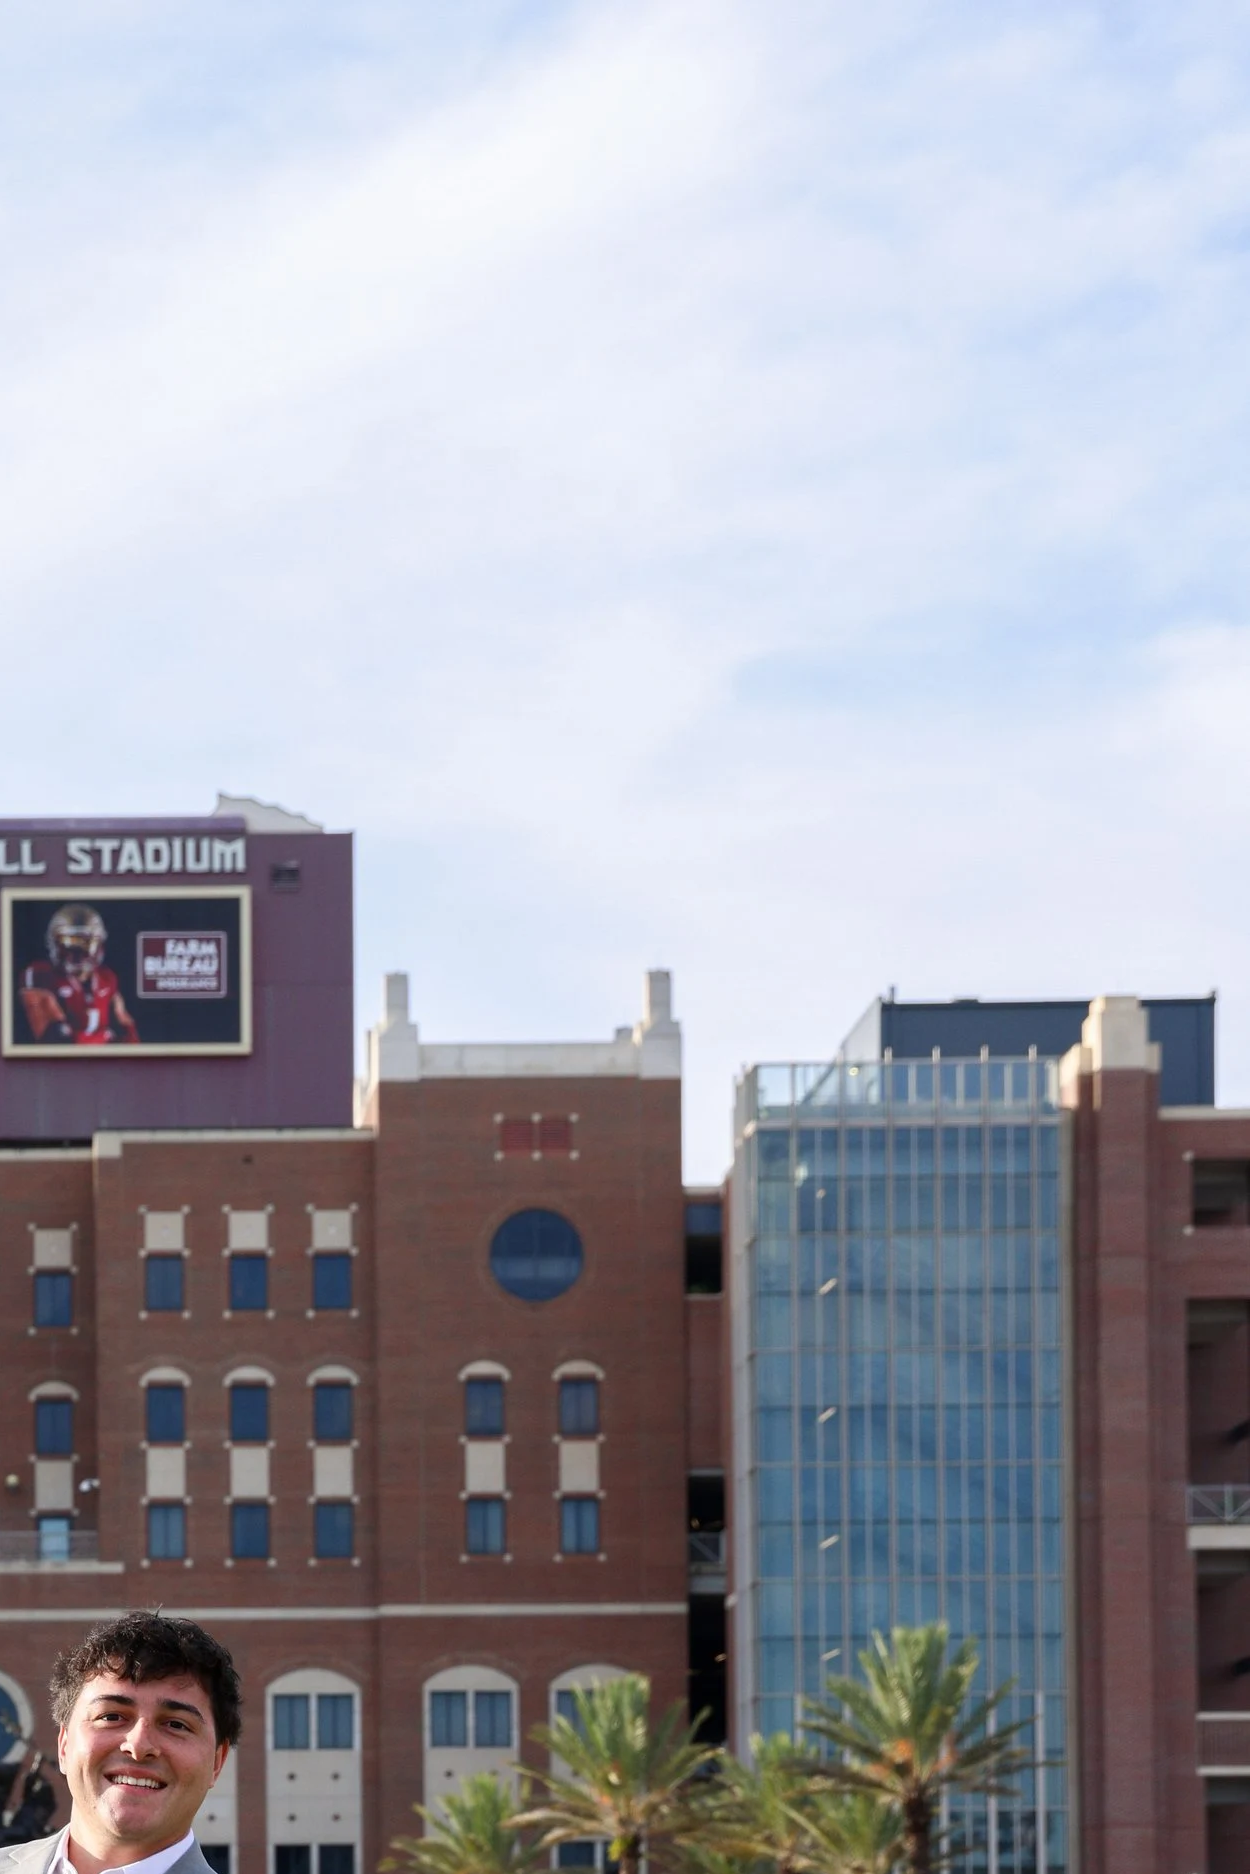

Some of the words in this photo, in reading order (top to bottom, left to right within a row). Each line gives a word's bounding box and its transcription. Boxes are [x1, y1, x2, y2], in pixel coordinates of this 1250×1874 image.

[66, 836, 246, 874] STADIUM
[165, 939, 218, 955] FARM
[144, 956, 218, 975] BUREAU
